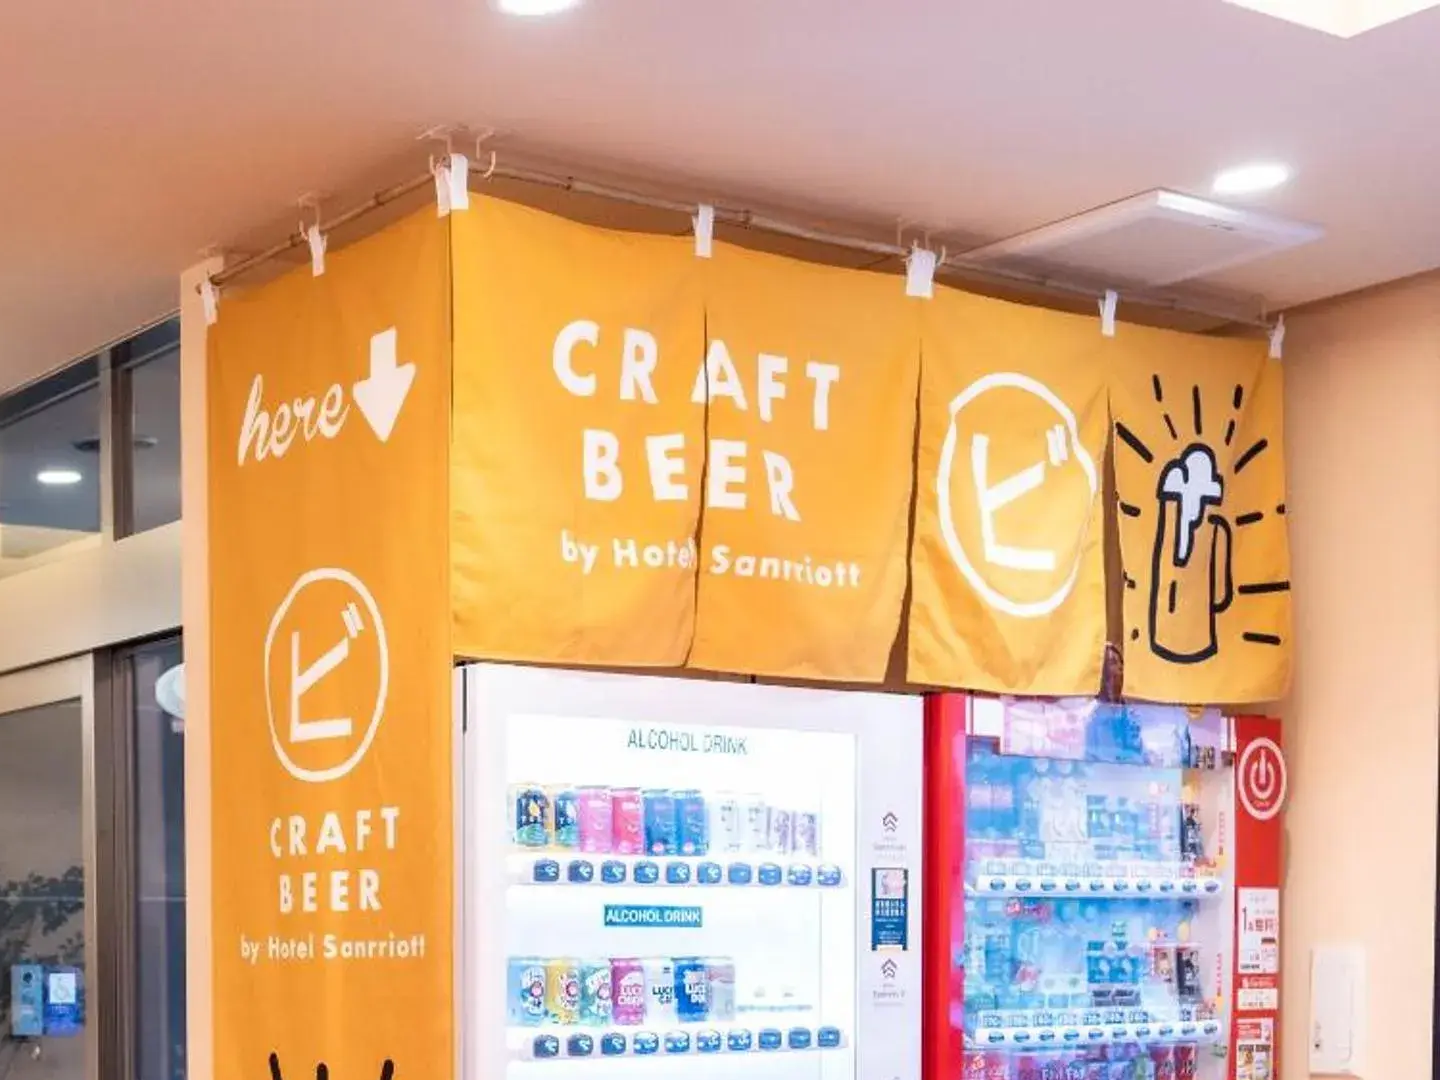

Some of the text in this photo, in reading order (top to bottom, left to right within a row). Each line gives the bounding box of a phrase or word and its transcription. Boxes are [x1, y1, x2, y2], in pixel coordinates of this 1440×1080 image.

[553, 320, 840, 431] CRAFT
[238, 374, 351, 467] here
[582, 429, 802, 522] BEER
[561, 528, 861, 587] by Hotel Sanrriott
[627, 727, 748, 756] ALCOHOL DRINK
[269, 806, 400, 858] CRAFT
[279, 868, 382, 914] BEER
[606, 908, 701, 924] ALCOHOL DRINK
[240, 931, 426, 965] by Hotel Sanrriott
